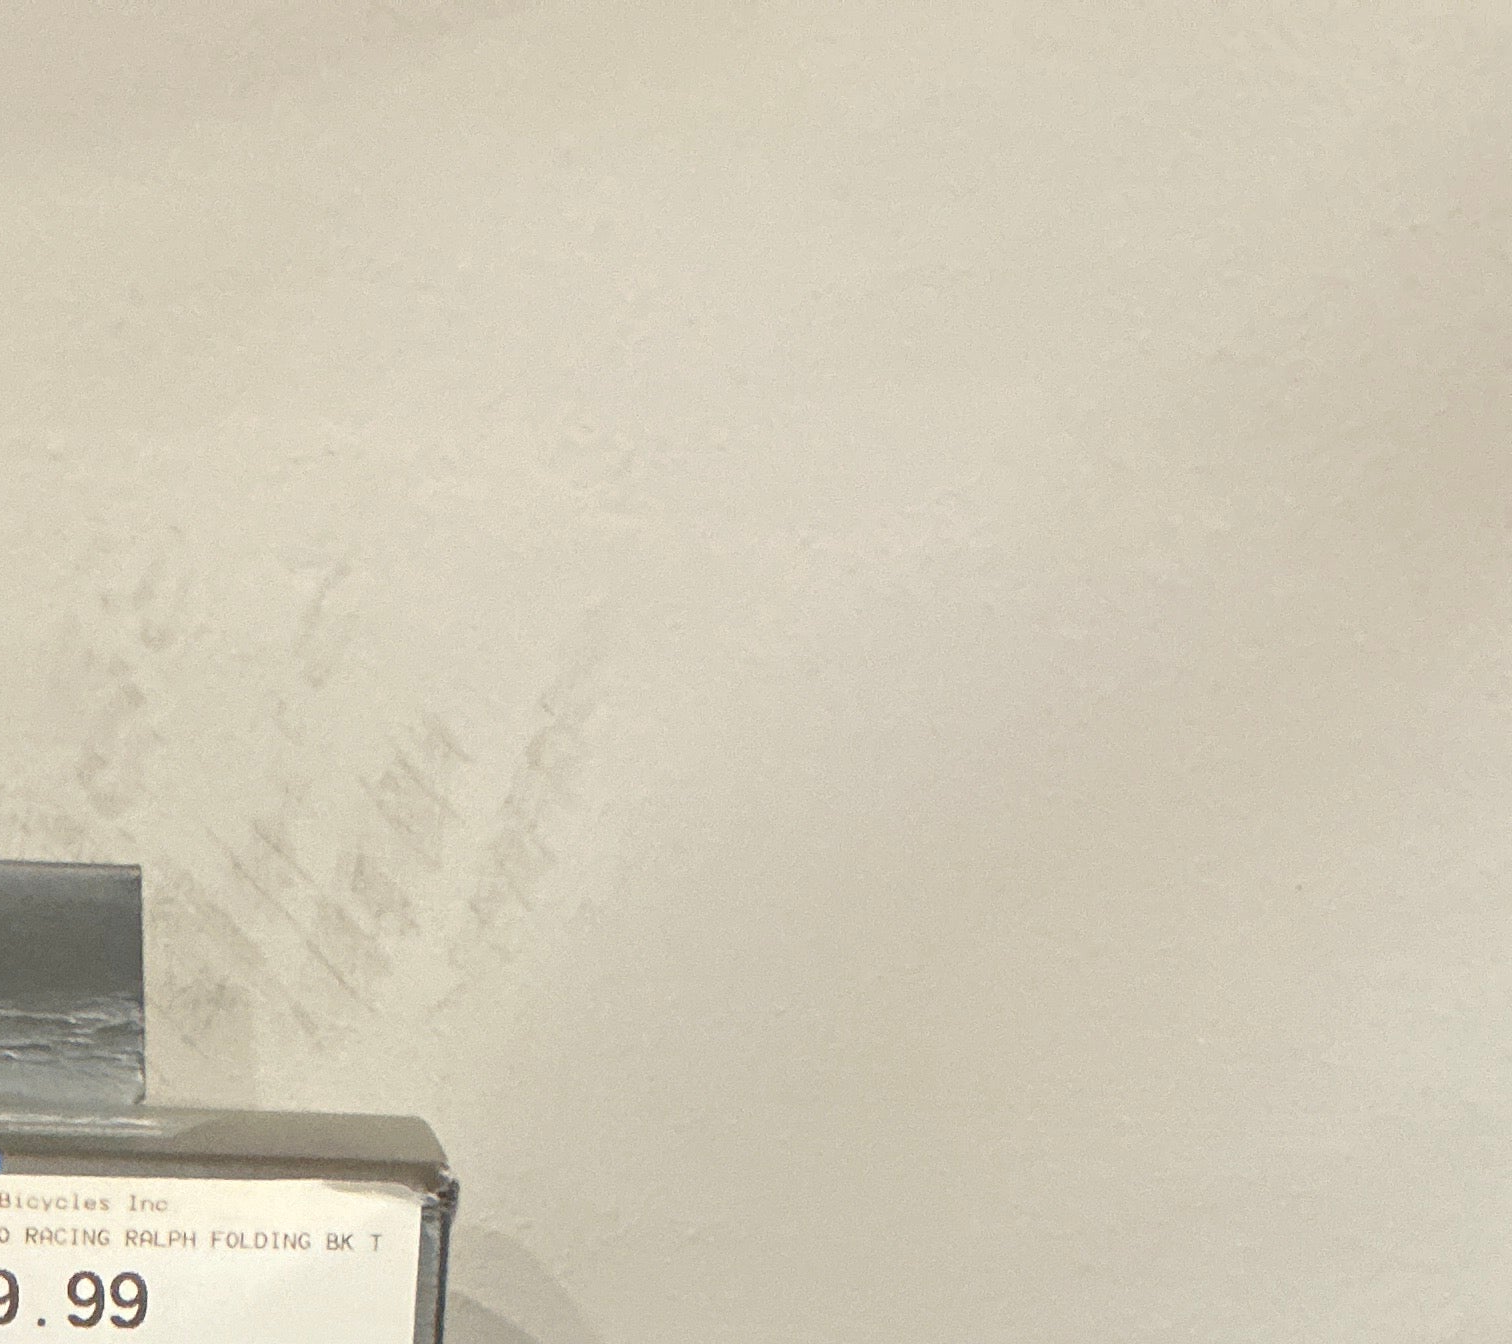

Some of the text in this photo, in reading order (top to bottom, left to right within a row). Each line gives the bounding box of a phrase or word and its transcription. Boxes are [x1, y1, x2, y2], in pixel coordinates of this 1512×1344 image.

[129, 1195, 170, 1213] Inc
[24, 1227, 111, 1247] RACING
[124, 1229, 197, 1249] RALPH
[210, 1231, 312, 1251] FOLDING
[326, 1233, 354, 1252] BK
[369, 1234, 386, 1252] T
